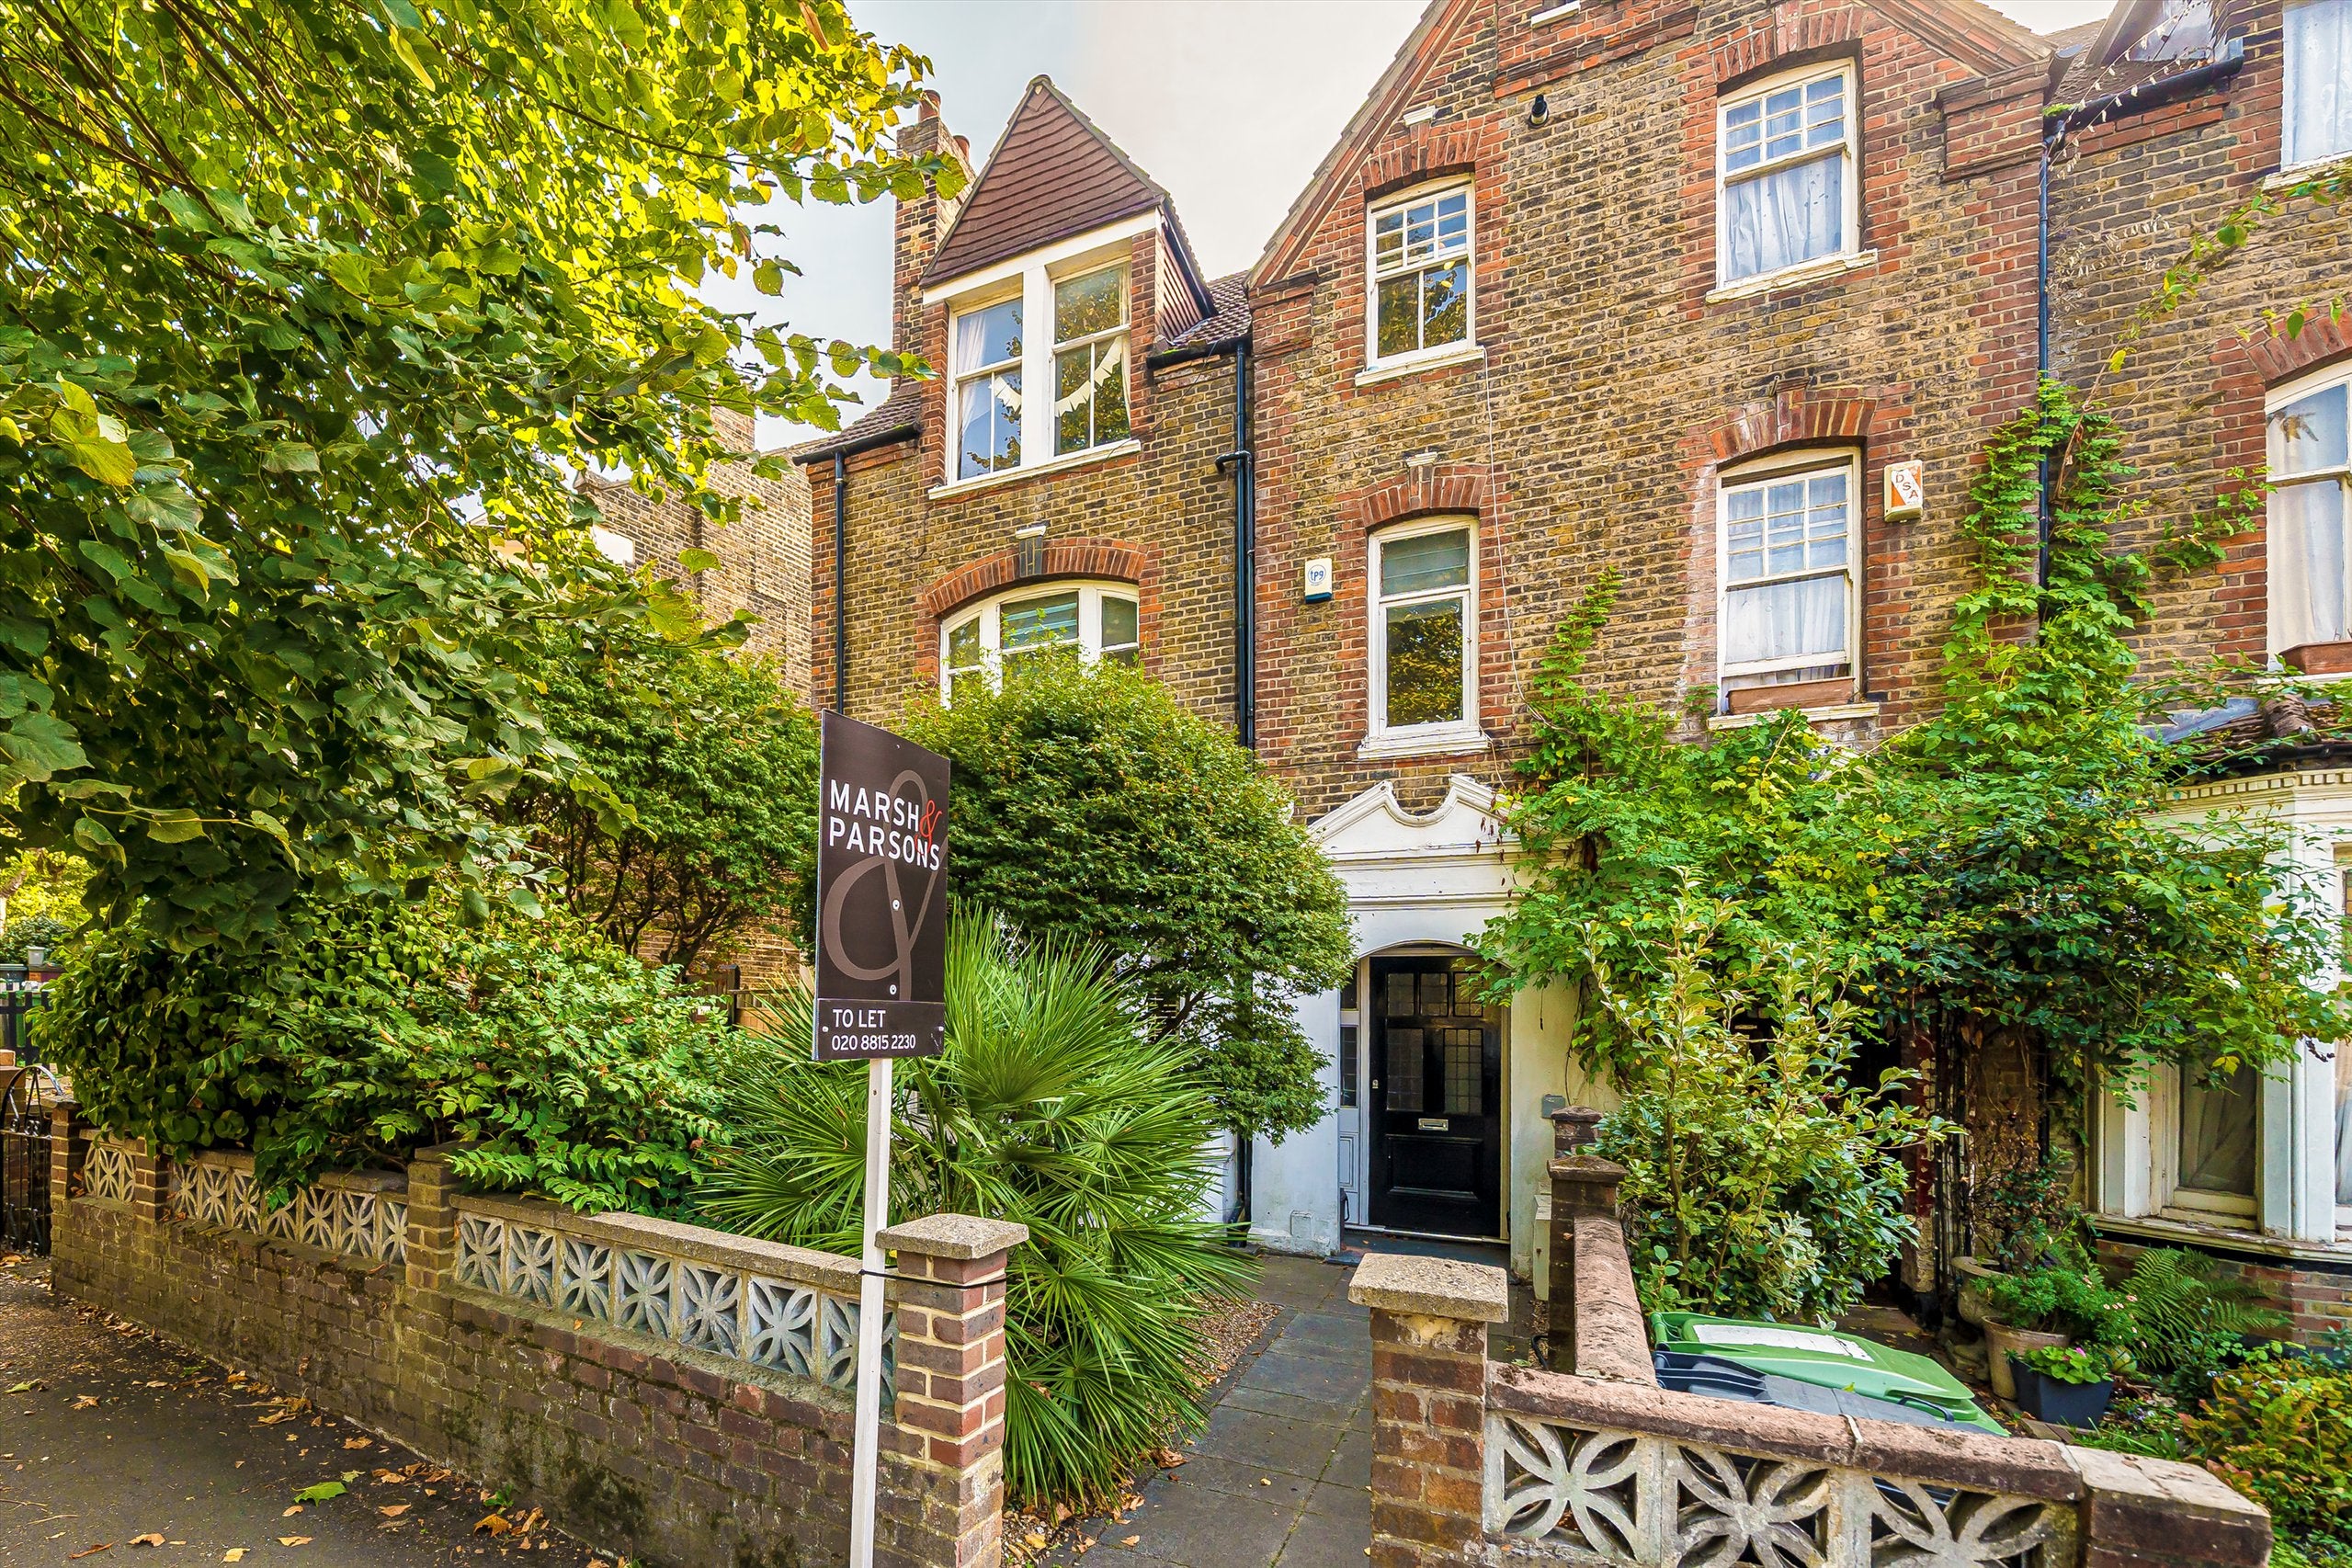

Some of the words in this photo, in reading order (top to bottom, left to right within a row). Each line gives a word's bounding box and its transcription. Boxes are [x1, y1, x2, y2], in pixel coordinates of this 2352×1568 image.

[1896, 474, 1918, 498] DSA
[830, 779, 919, 832] MARSH
[915, 800, 942, 854] &
[829, 816, 940, 870] PARSONS
[833, 1009, 853, 1028] TO
[858, 1010, 886, 1028] LET
[832, 1035, 858, 1051] 020
[861, 1035, 889, 1050] 8815
[892, 1035, 915, 1049] 2230
